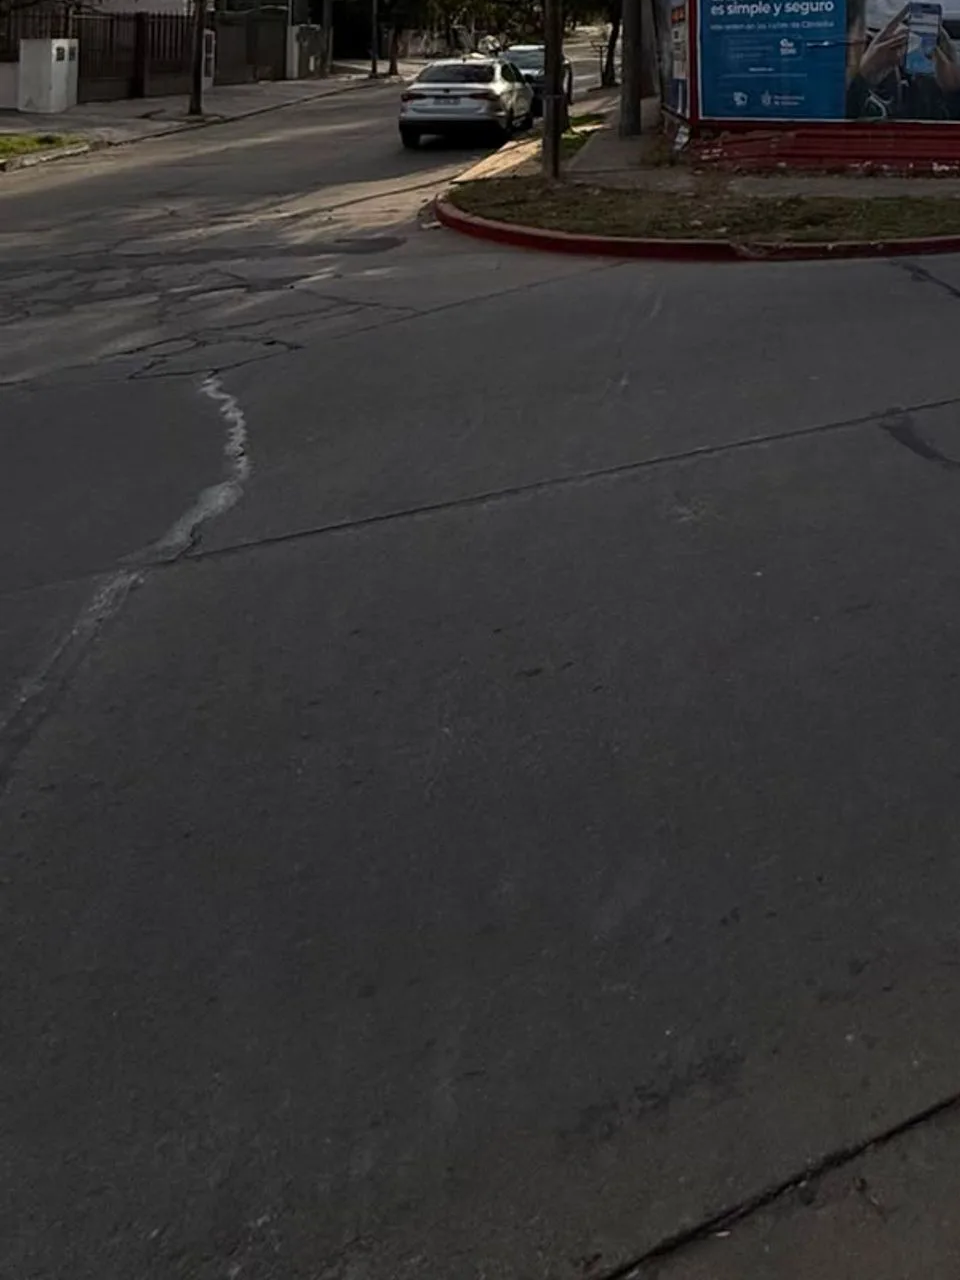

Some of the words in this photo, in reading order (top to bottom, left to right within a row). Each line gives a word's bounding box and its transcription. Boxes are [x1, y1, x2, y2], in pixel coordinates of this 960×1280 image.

[710, 4, 725, 16] es
[727, 1, 771, 18] simple
[772, 3, 782, 17] y
[783, 0, 835, 16] seguro
